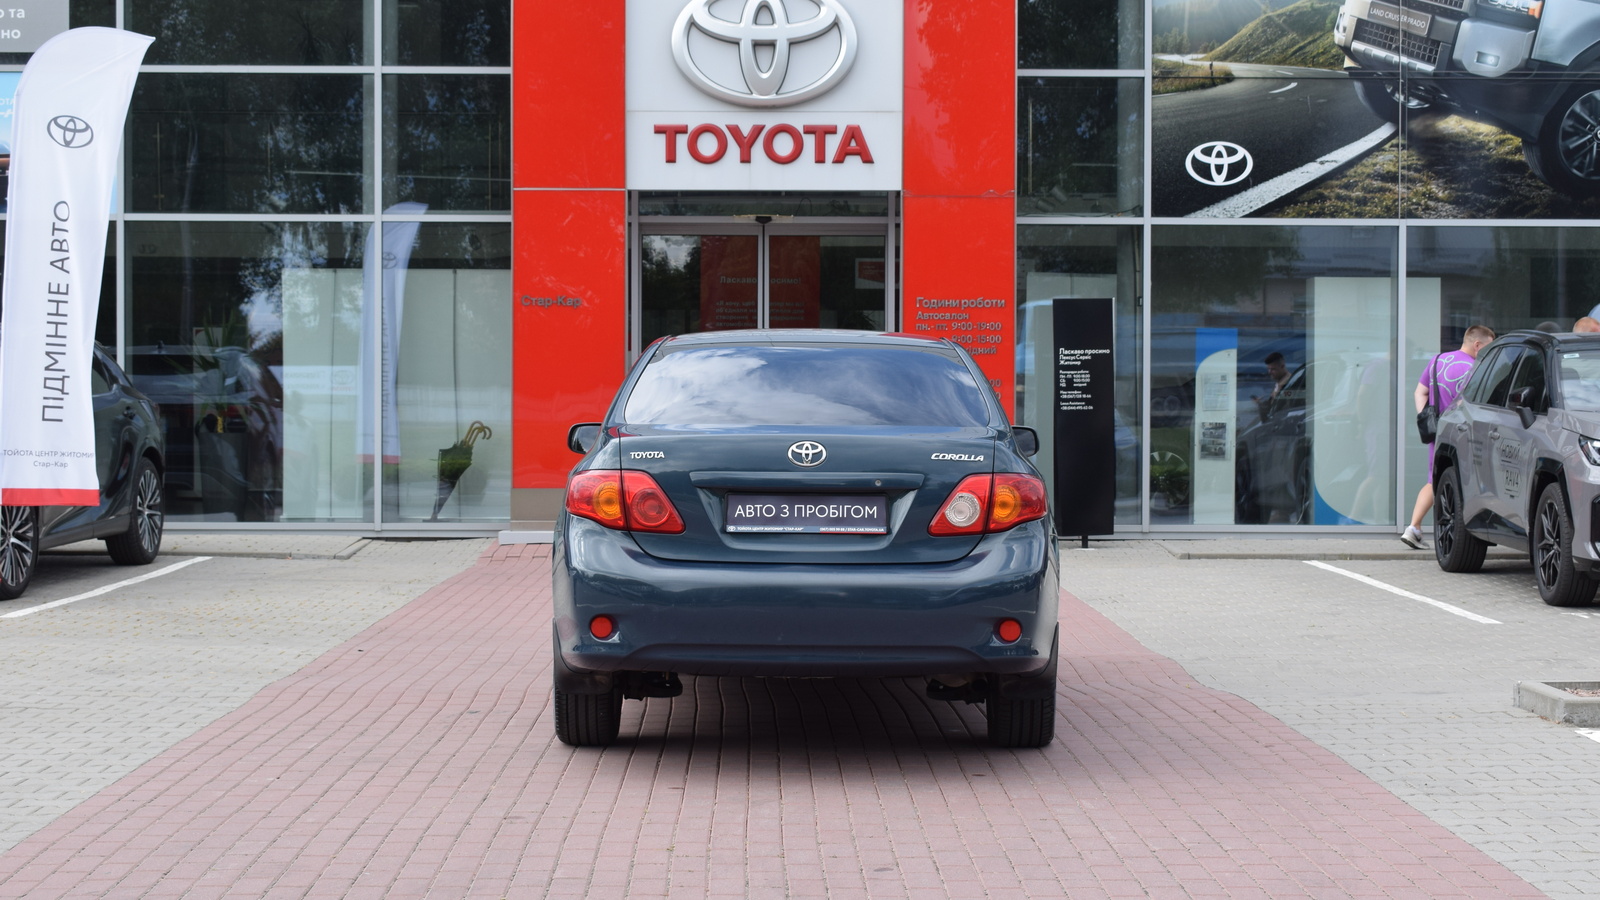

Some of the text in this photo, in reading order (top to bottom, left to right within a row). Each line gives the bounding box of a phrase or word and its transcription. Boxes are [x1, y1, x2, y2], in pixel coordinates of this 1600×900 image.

[1370, 7, 1385, 17] LAND
[1407, 17, 1426, 28] PRADO
[653, 124, 874, 165] TOYOTA
[521, 295, 583, 309] Стар-Кар
[916, 297, 1006, 309] Години роботи
[42, 201, 70, 422] ПІДМІННЕ АВТО
[916, 311, 969, 320] Автосалон
[951, 322, 1002, 331] 9:00-19:00
[3, 449, 34, 457] ТОЙОТА
[630, 451, 665, 459] TOYOTA
[931, 452, 984, 462] COROLLA
[734, 504, 776, 518] АВТО
[794, 504, 877, 519] ПРОБІГОМ
